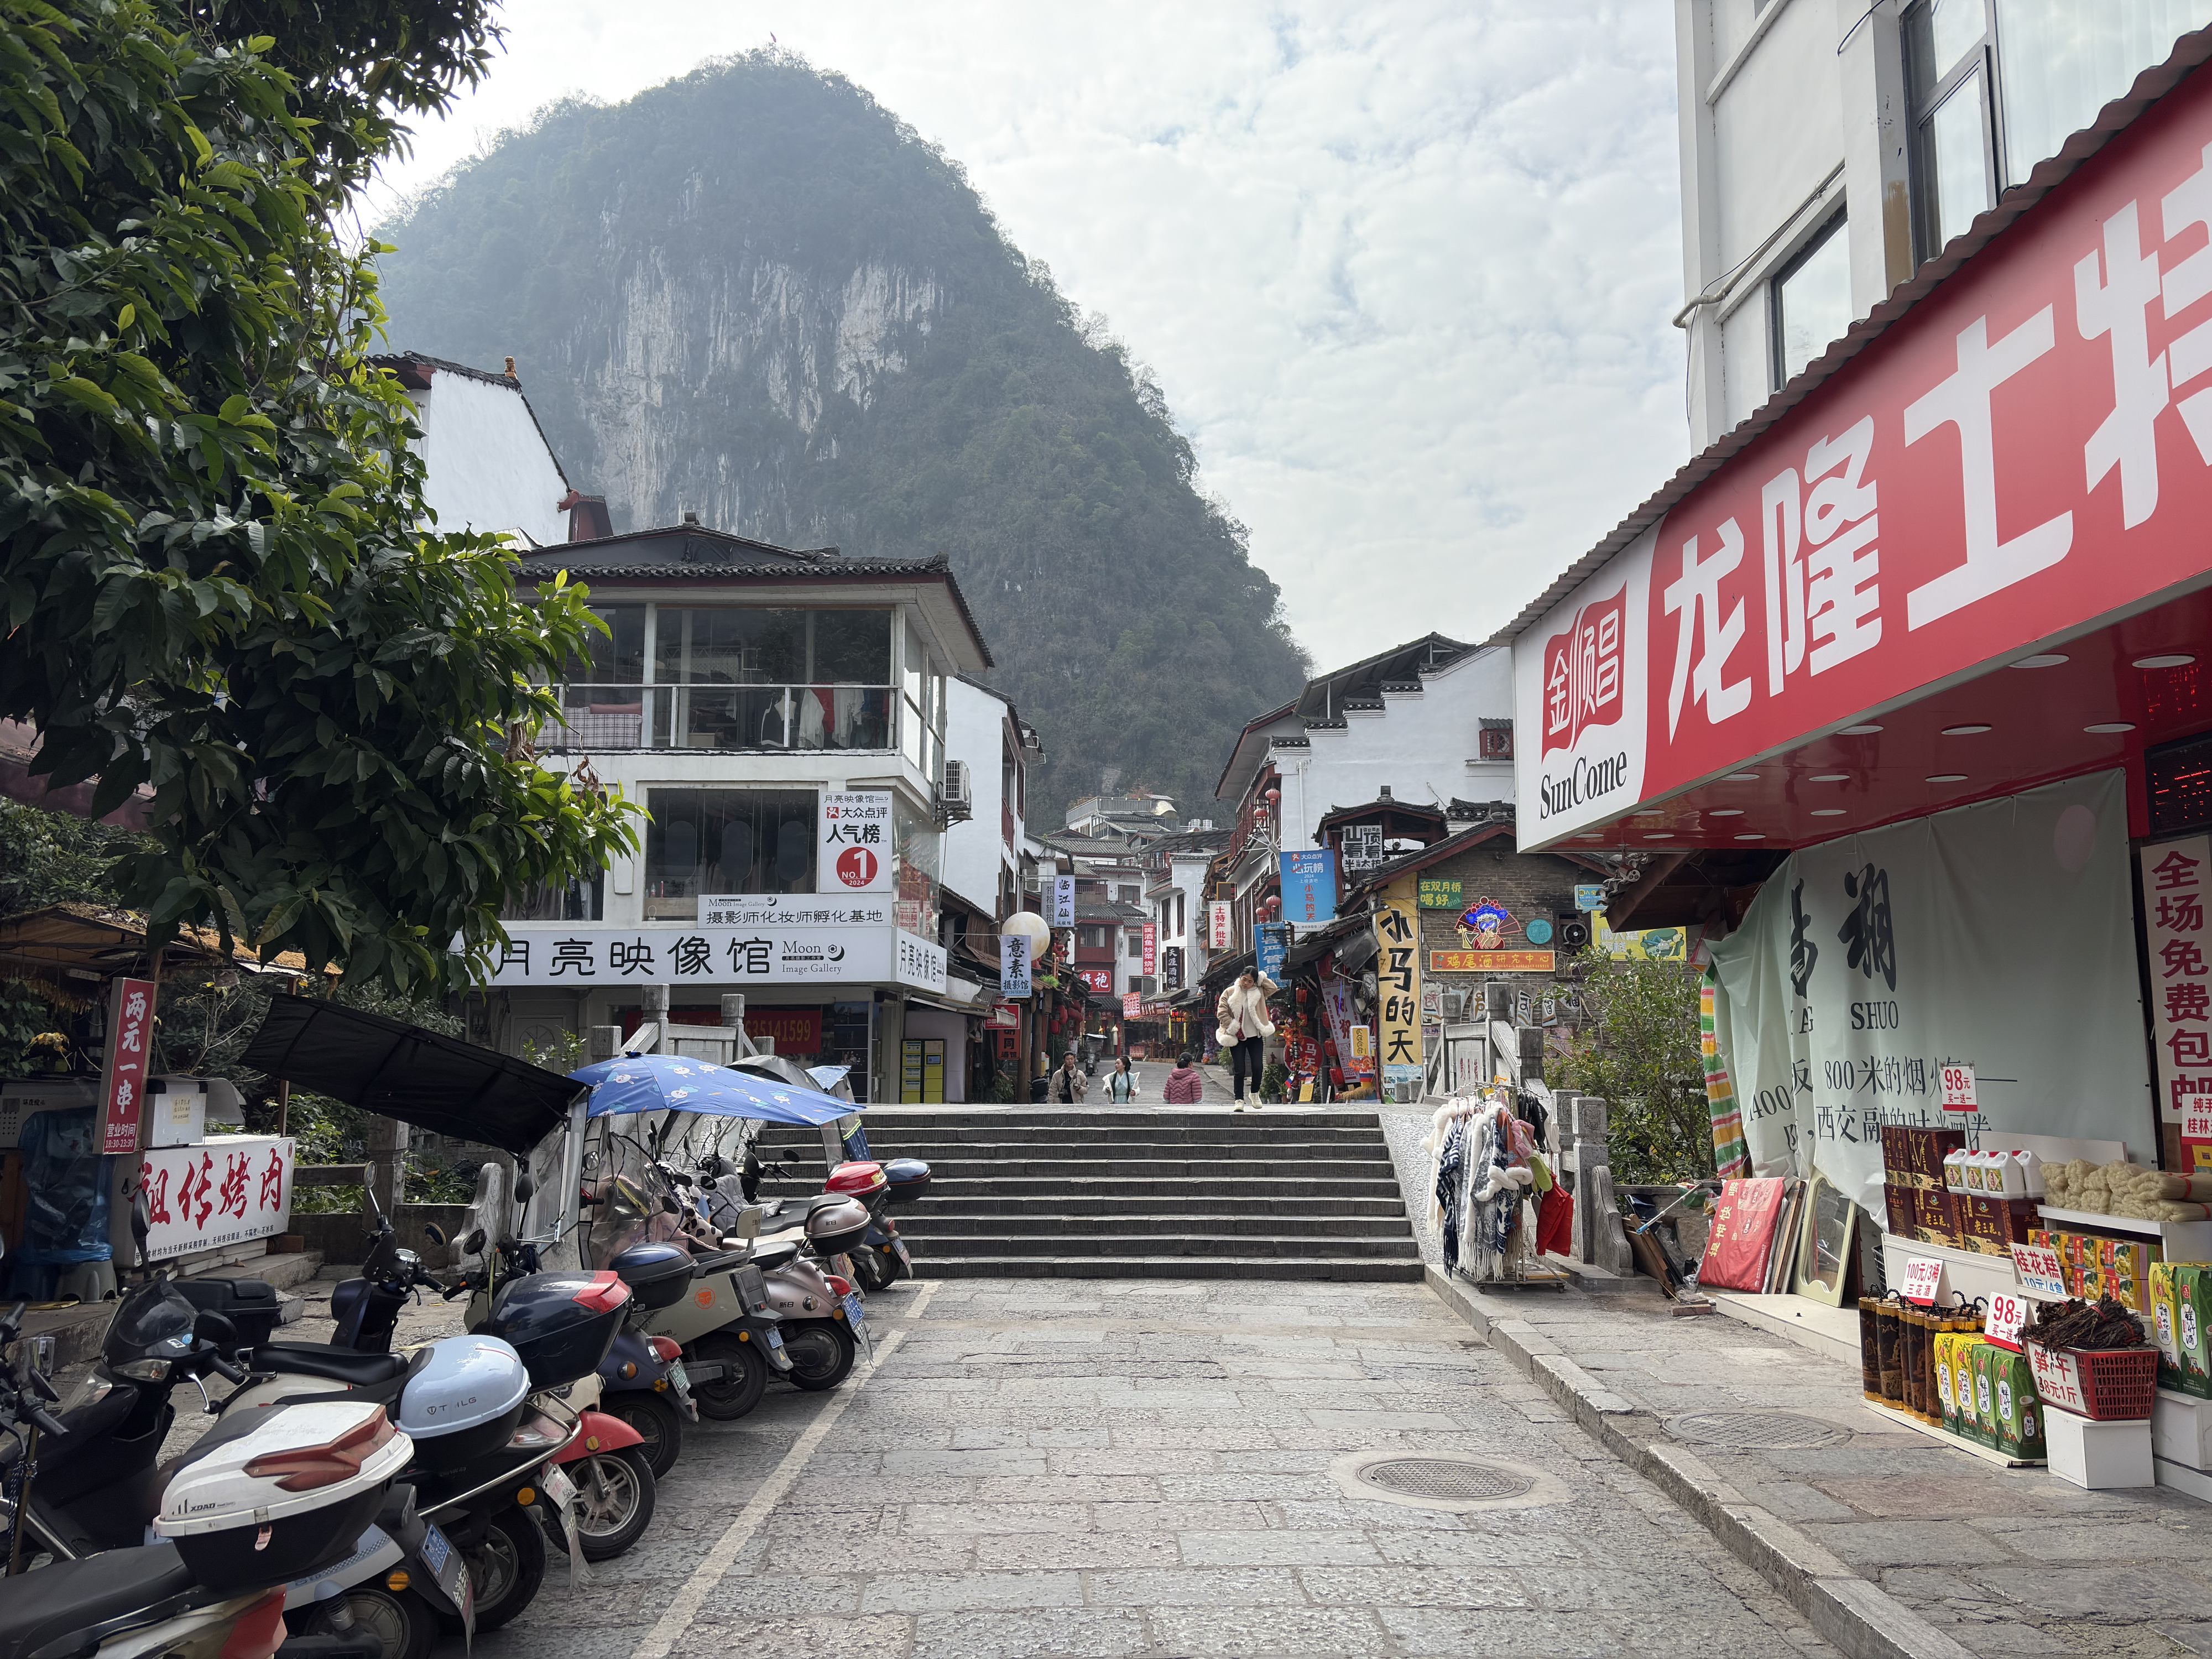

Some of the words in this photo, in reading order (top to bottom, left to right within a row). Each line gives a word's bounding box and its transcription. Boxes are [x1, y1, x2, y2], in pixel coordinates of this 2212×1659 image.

[1540, 751, 1627, 821] SunCome
[824, 795, 874, 803] 月亮映像馆
[841, 807, 887, 818] 大众点评
[826, 824, 880, 844] 人气榜
[1291, 863, 1324, 874] 必玩榜
[1420, 881, 1461, 893] 在双月桥
[708, 899, 732, 907] Moon
[1058, 879, 1071, 918] 临江仙
[1305, 884, 1316, 922] 小马的天
[1420, 894, 1449, 907] 喝好
[1447, 897, 1462, 908] drink
[706, 909, 884, 925] 摄影师化妆师孵化基地
[1215, 906, 1226, 947] 土特产批发
[782, 941, 822, 953] Moon
[495, 937, 773, 976] 月亮映像馆
[900, 940, 937, 983] 月亮映像馆
[1006, 938, 1025, 979] 意素
[1447, 953, 1493, 969] 鸡尾酒
[1496, 953, 1550, 964] 研究中心
[782, 964, 808, 975] Image
[811, 964, 842, 975] Gallery
[1168, 948, 1178, 985] 天涯酒馆
[1003, 980, 1029, 990] 摄影馆
[1379, 910, 1416, 1064] 小马的天
[1851, 1000, 1899, 1030] SHUO
[117, 992, 147, 1115] 两元一串
[1944, 1068, 1970, 1091] 98元
[1947, 1093, 1972, 1104] 买一送一
[107, 1123, 137, 1138] 营业时间
[105, 1138, 134, 1149] 18:30-23:30
[127, 1147, 283, 1231] 祖传烤肉
[2014, 1248, 2061, 1279] 桂花糕
[1907, 1262, 1940, 1284] 100元/3桶
[1907, 1284, 1932, 1297] 三花酒
[1993, 1296, 2022, 1326] 98元
[439, 1396, 477, 1411] TILG
